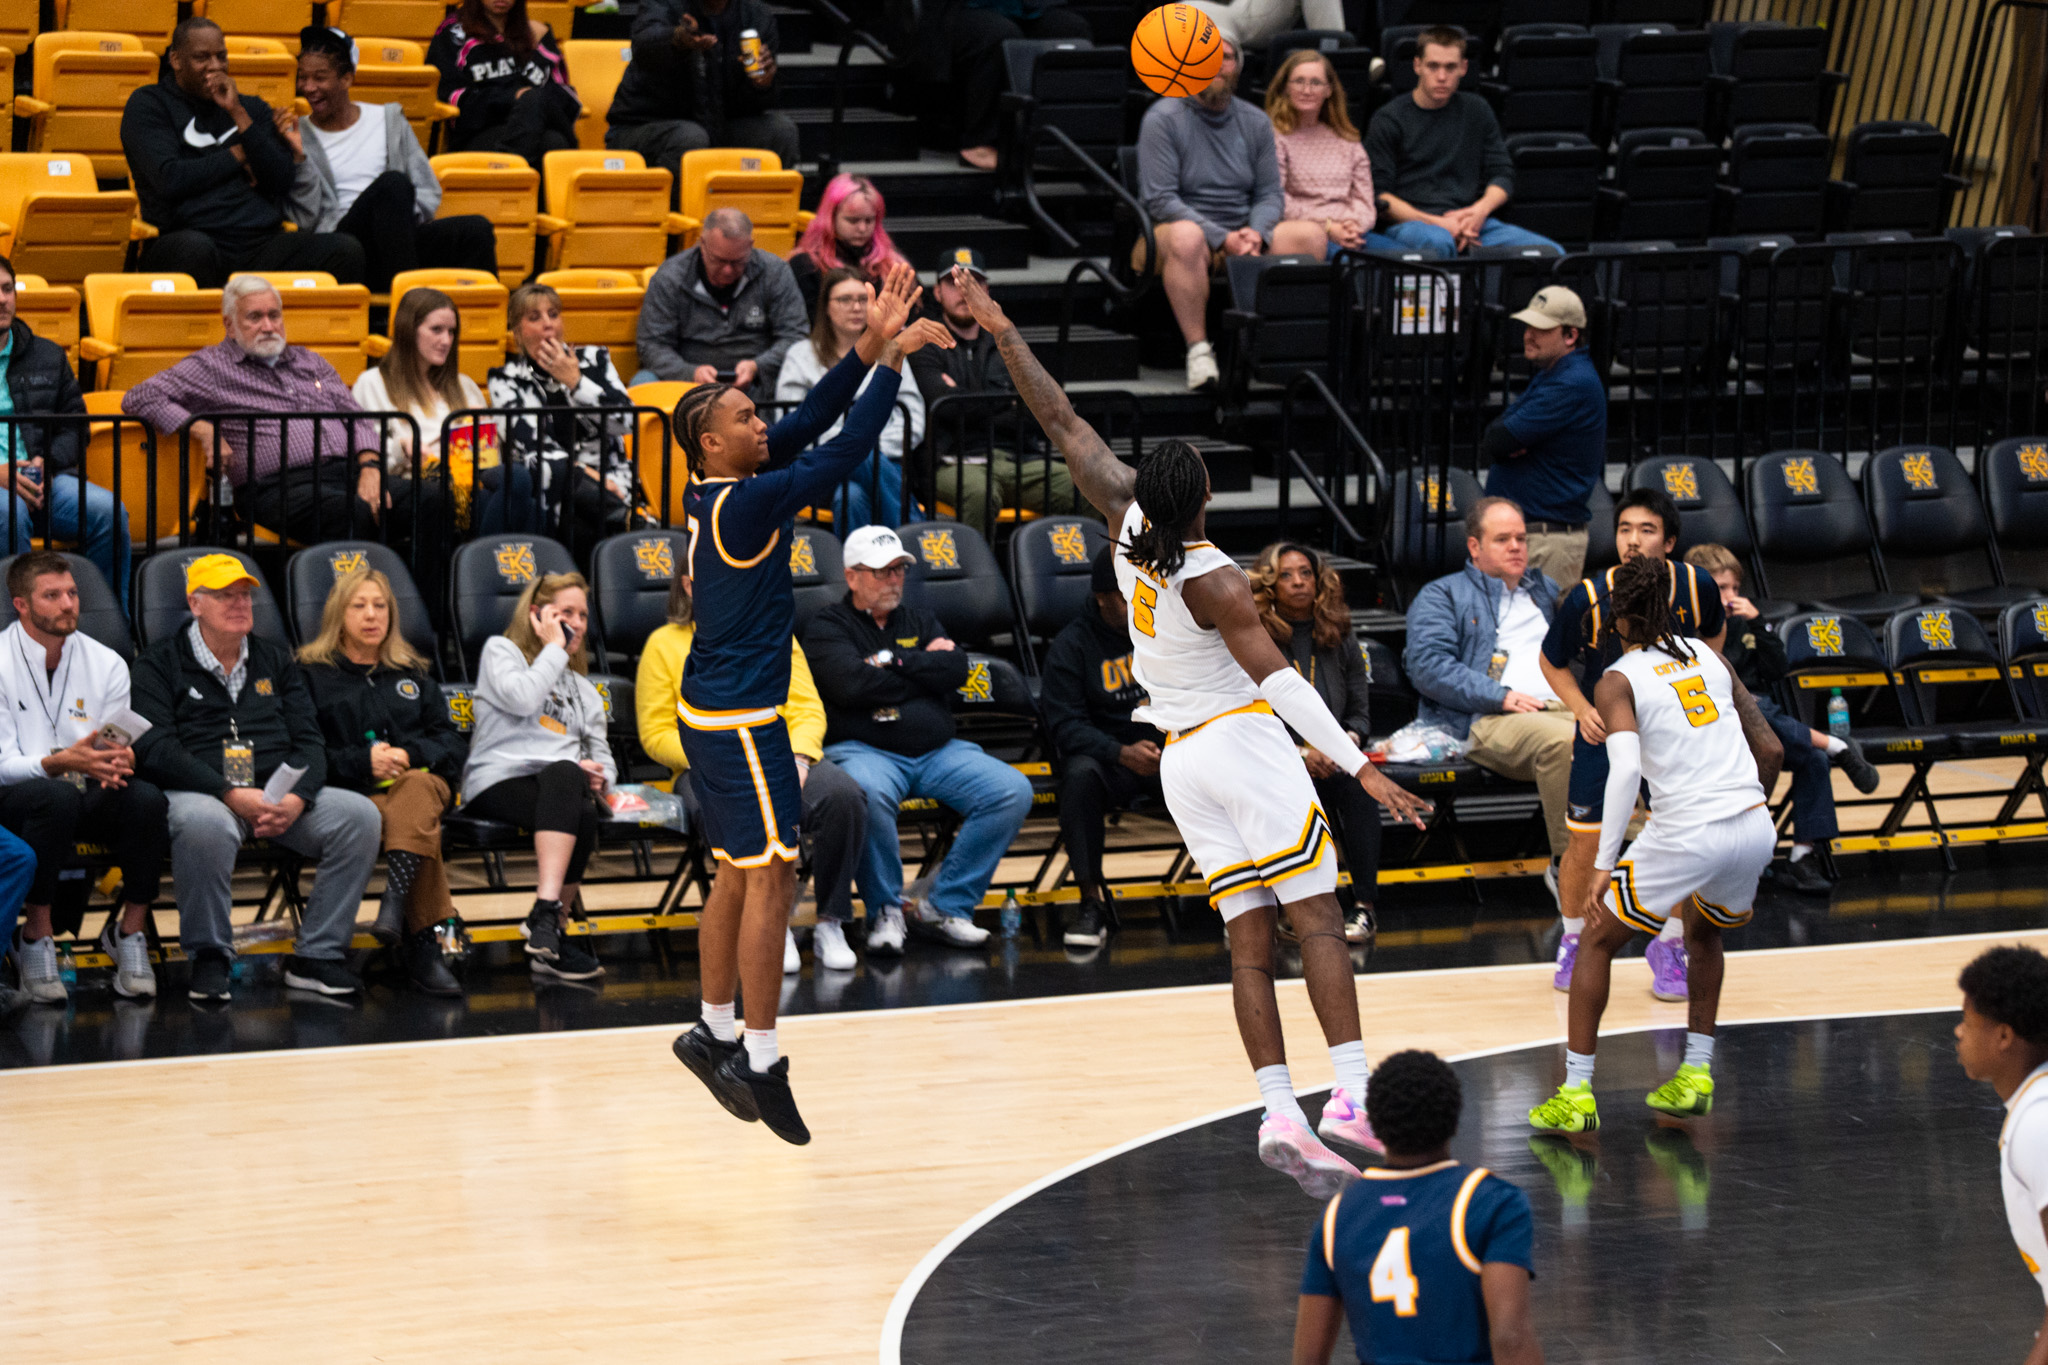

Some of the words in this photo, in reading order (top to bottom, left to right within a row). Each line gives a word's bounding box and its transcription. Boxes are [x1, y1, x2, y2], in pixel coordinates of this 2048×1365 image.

[1668, 674, 1719, 728] 5
[1419, 771, 1456, 784] OWLS
[1369, 1227, 1419, 1317] 4
